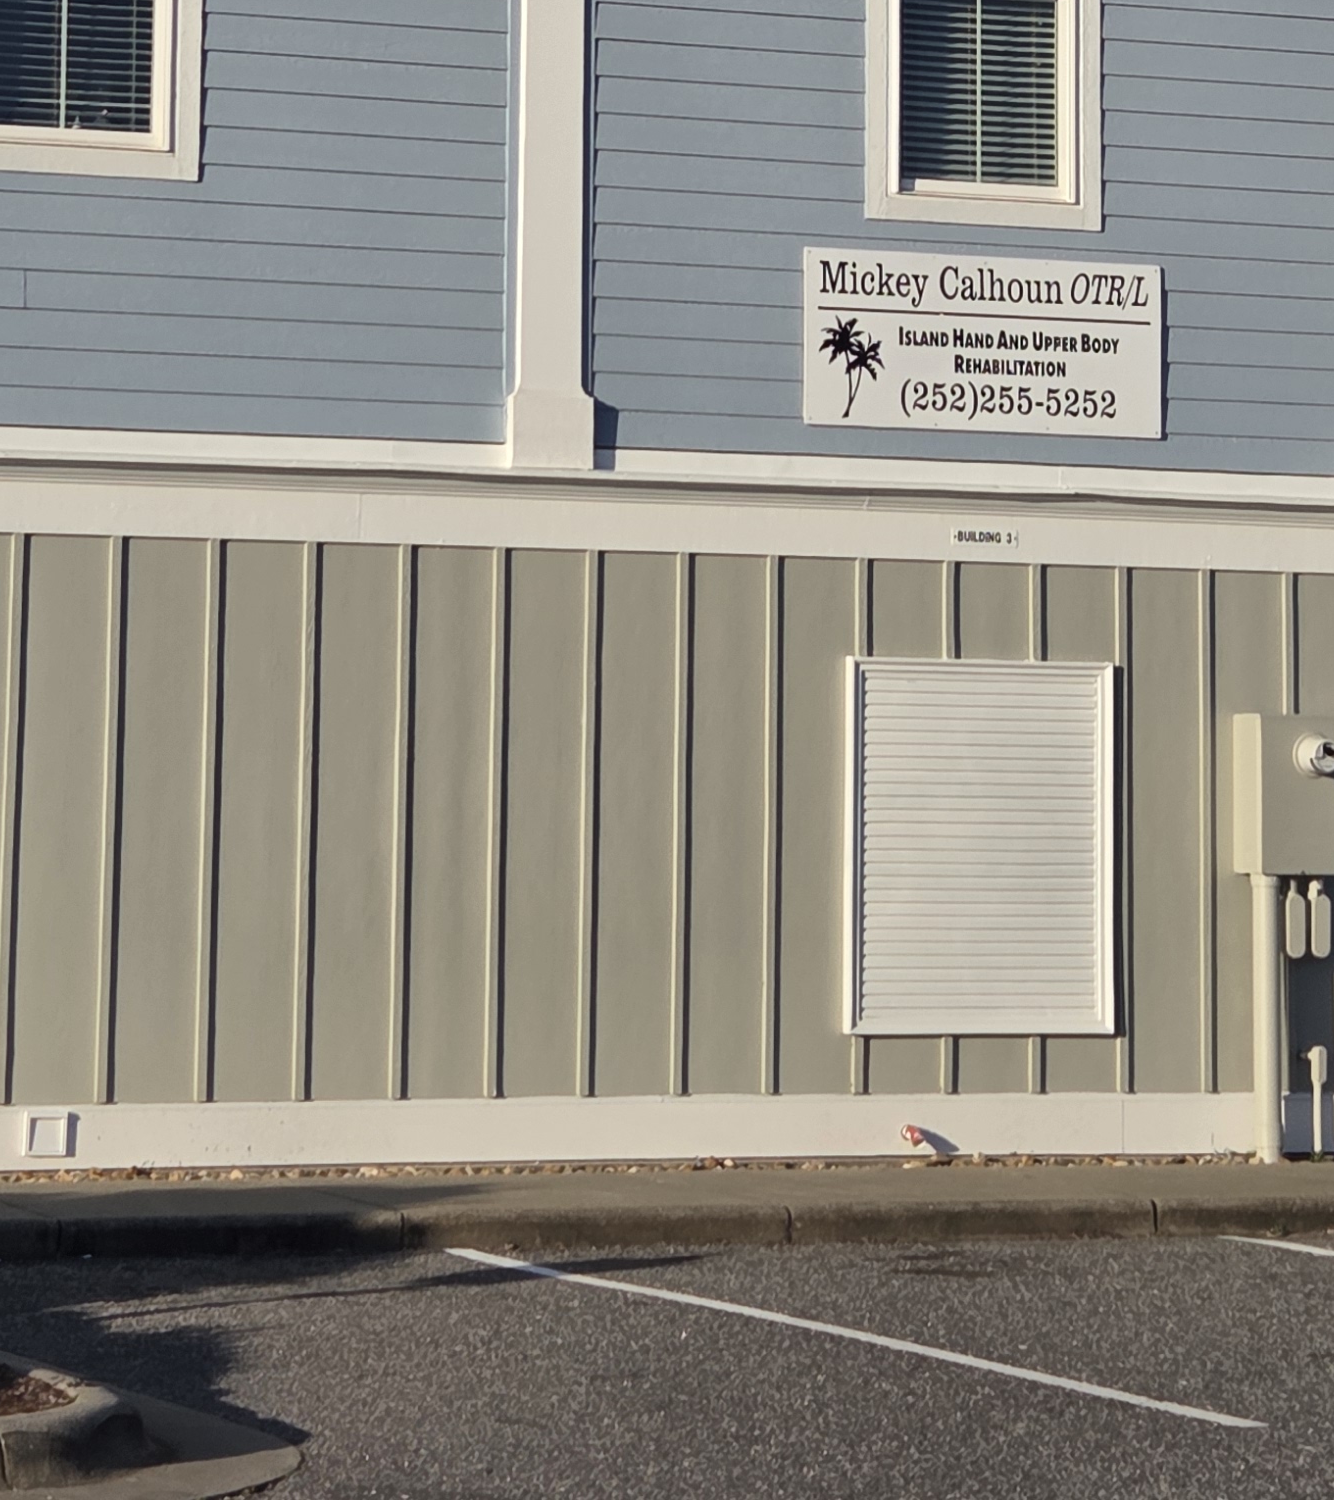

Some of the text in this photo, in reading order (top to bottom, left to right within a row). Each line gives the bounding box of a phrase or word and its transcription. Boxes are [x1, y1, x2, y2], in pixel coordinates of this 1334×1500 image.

[819, 259, 1149, 310] Mickey Calhoun OTR/L
[900, 378, 1117, 420] (252)255-5252
